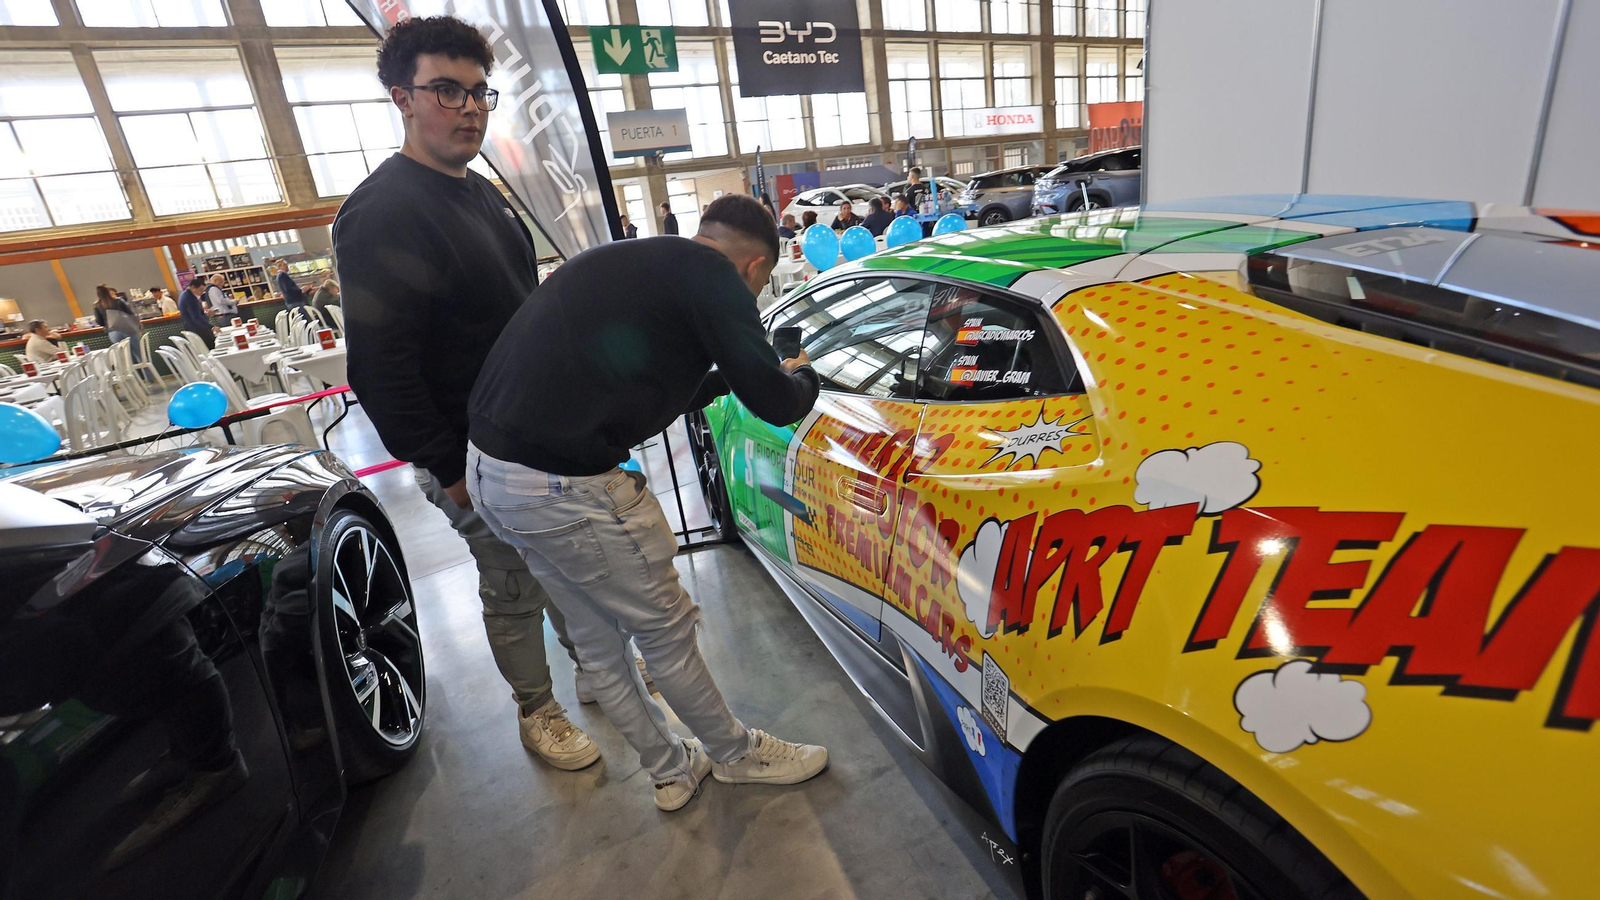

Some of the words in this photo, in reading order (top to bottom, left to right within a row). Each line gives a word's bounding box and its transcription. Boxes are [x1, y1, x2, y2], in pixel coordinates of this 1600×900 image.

[758, 20, 837, 44] BYD
[763, 50, 817, 65] Caetano
[817, 50, 839, 65] Tec
[986, 113, 1035, 126] HONDA
[621, 126, 664, 141] PUERTA
[671, 125, 678, 137] 1
[964, 317, 984, 328] SPAIN
[957, 355, 980, 366] SPAIN
[960, 369, 1032, 384] @JAVIER_GRAM
[1007, 430, 1063, 448] DURRES
[756, 443, 787, 474] EUROPE
[789, 458, 816, 489] TOUR
[852, 470, 960, 590] MOTOR
[985, 502, 1200, 646] APRT
[827, 504, 912, 610] PREMIUM
[915, 584, 972, 673] CARS
